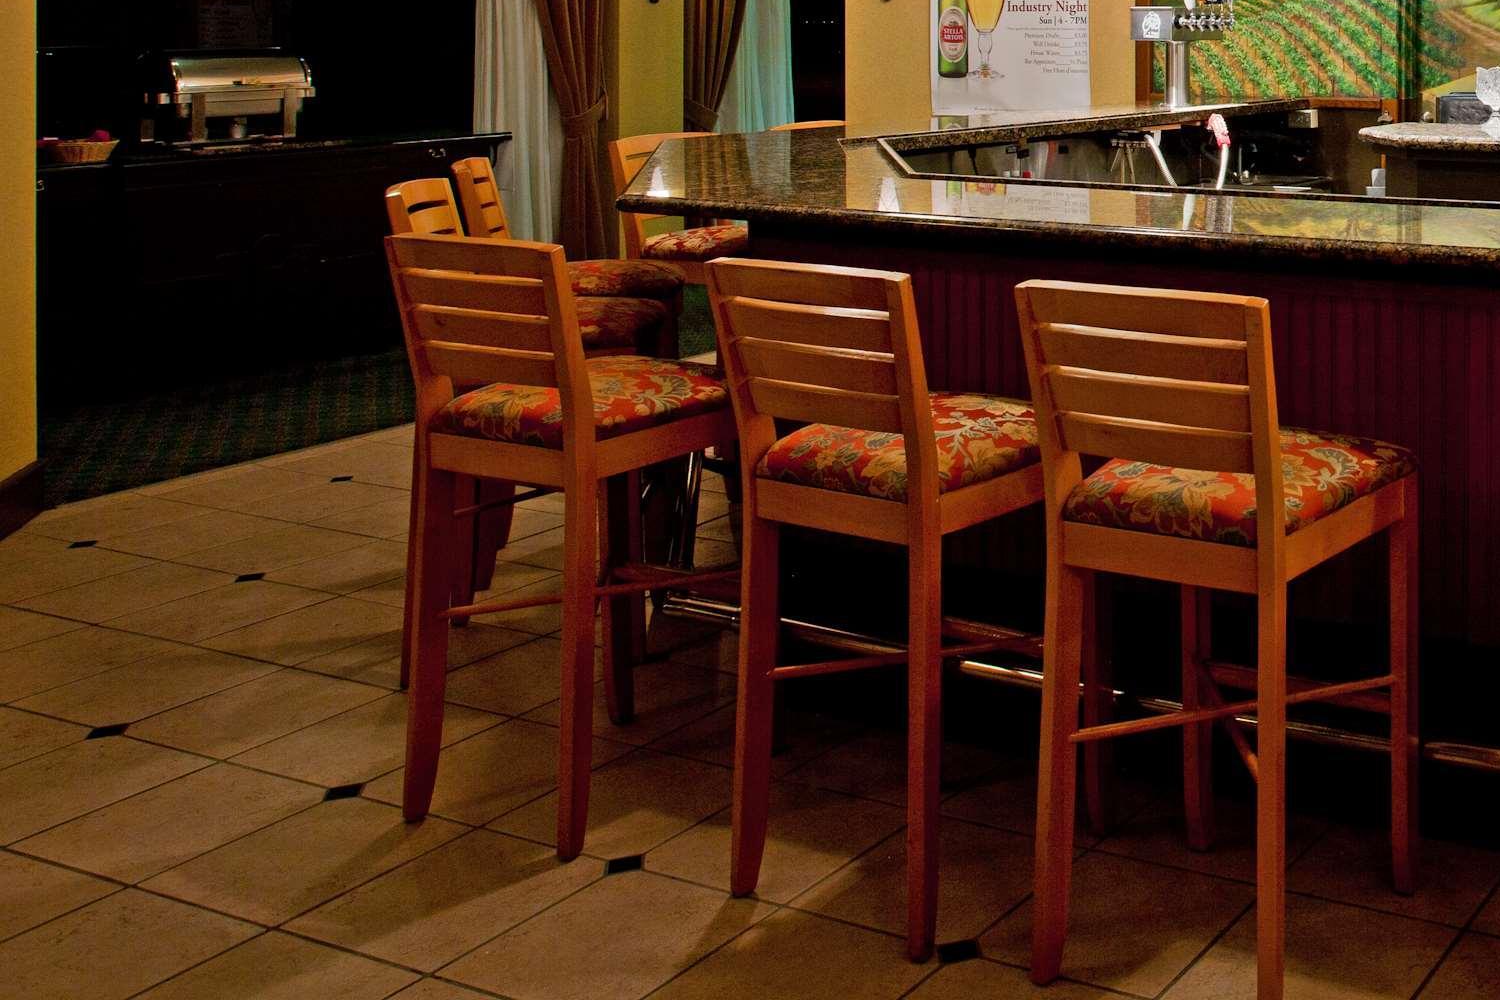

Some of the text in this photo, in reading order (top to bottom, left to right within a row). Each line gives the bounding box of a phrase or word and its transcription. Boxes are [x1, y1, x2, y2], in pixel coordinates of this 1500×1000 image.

[1007, 0, 1088, 16] Industry Night
[1039, 16, 1053, 25] Sun
[1070, 16, 1088, 25] 7PM
